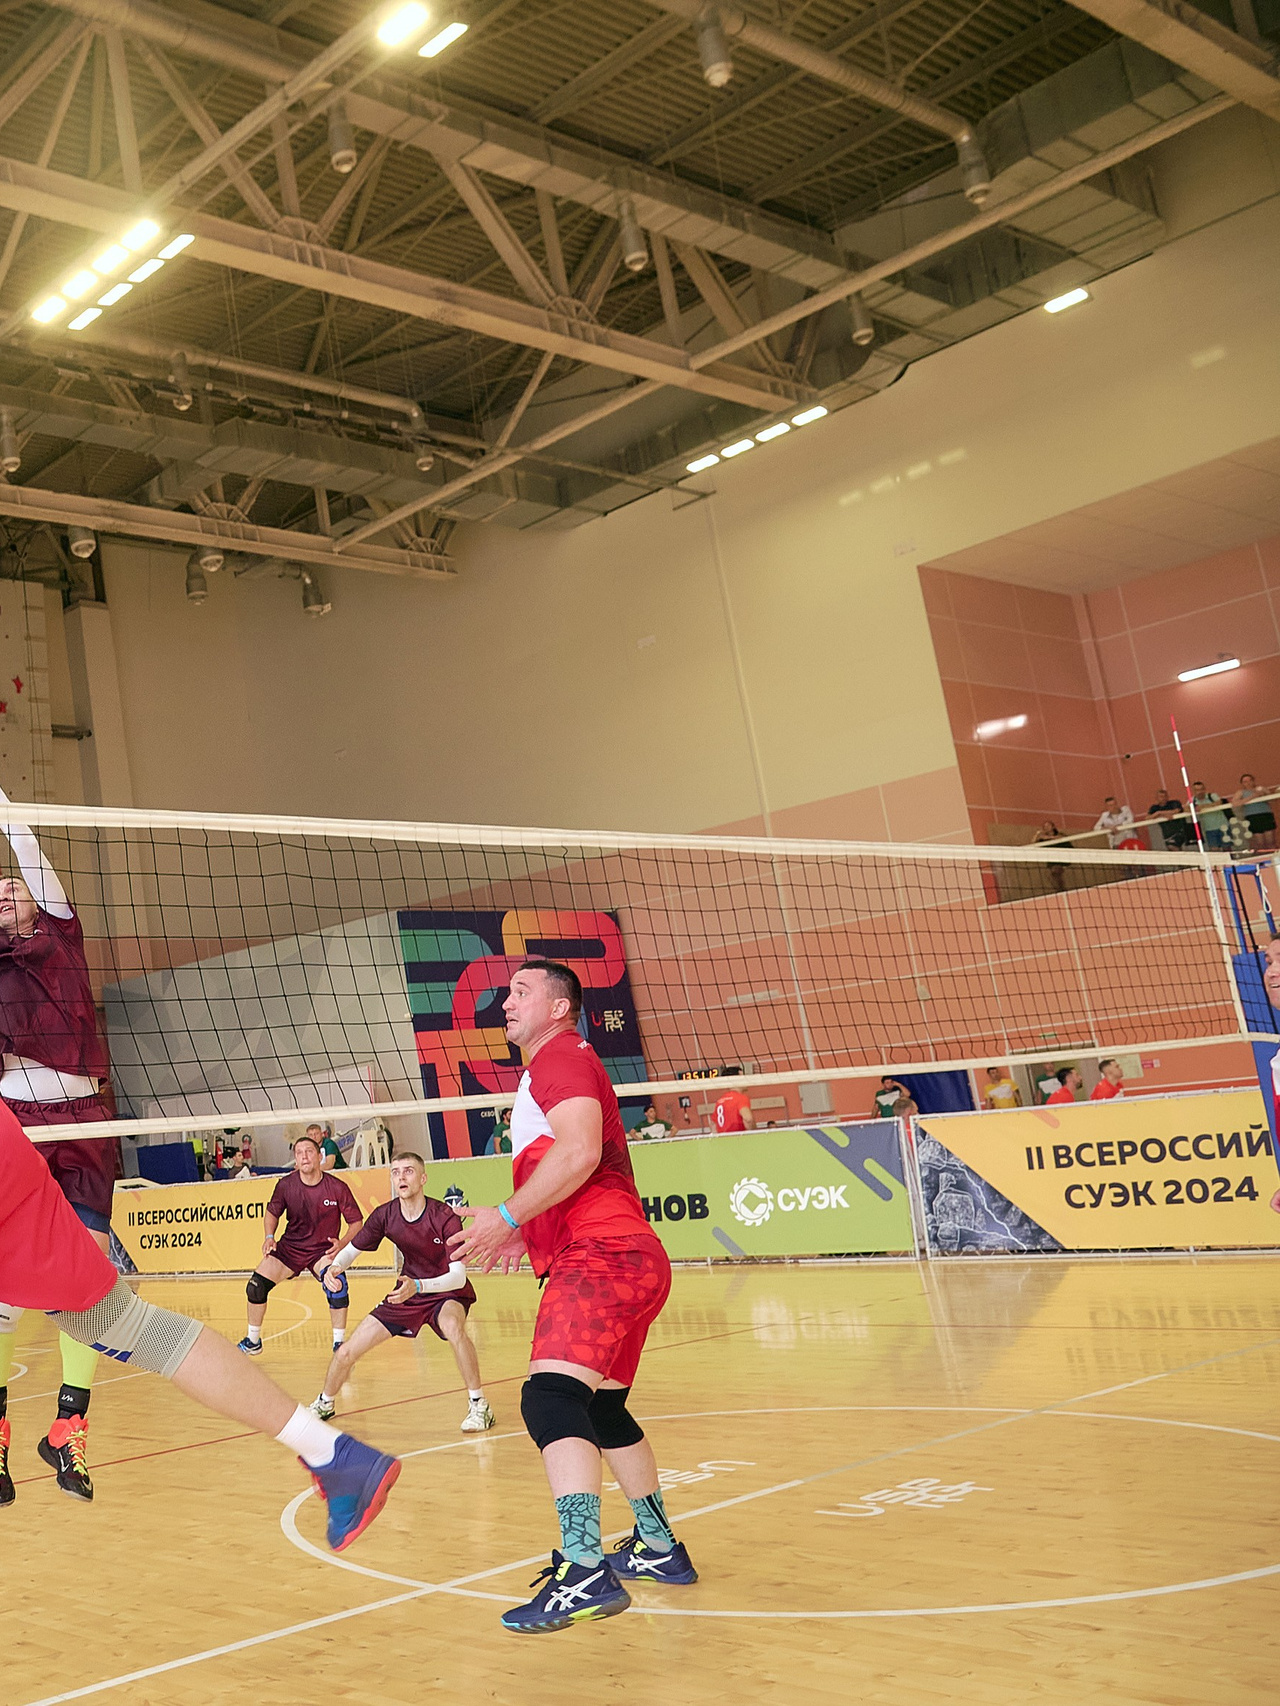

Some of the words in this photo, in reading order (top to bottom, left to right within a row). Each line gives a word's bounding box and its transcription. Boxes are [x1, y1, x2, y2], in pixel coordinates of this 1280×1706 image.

[717, 1105, 725, 1127] 8
[1026, 1146, 1045, 1170] II
[1052, 1123, 1273, 1169] ВСЕРОССИЙ
[777, 1185, 850, 1212] СУЭК
[1064, 1179, 1157, 1209] СУЭК
[1163, 1176, 1259, 1205] 2024
[128, 1212, 135, 1227] II
[137, 1203, 243, 1226] ВСЕРОССИЙСКАЯ
[246, 1202, 270, 1219] СП
[140, 1234, 169, 1249] СУЭК
[171, 1232, 202, 1248] 2024
